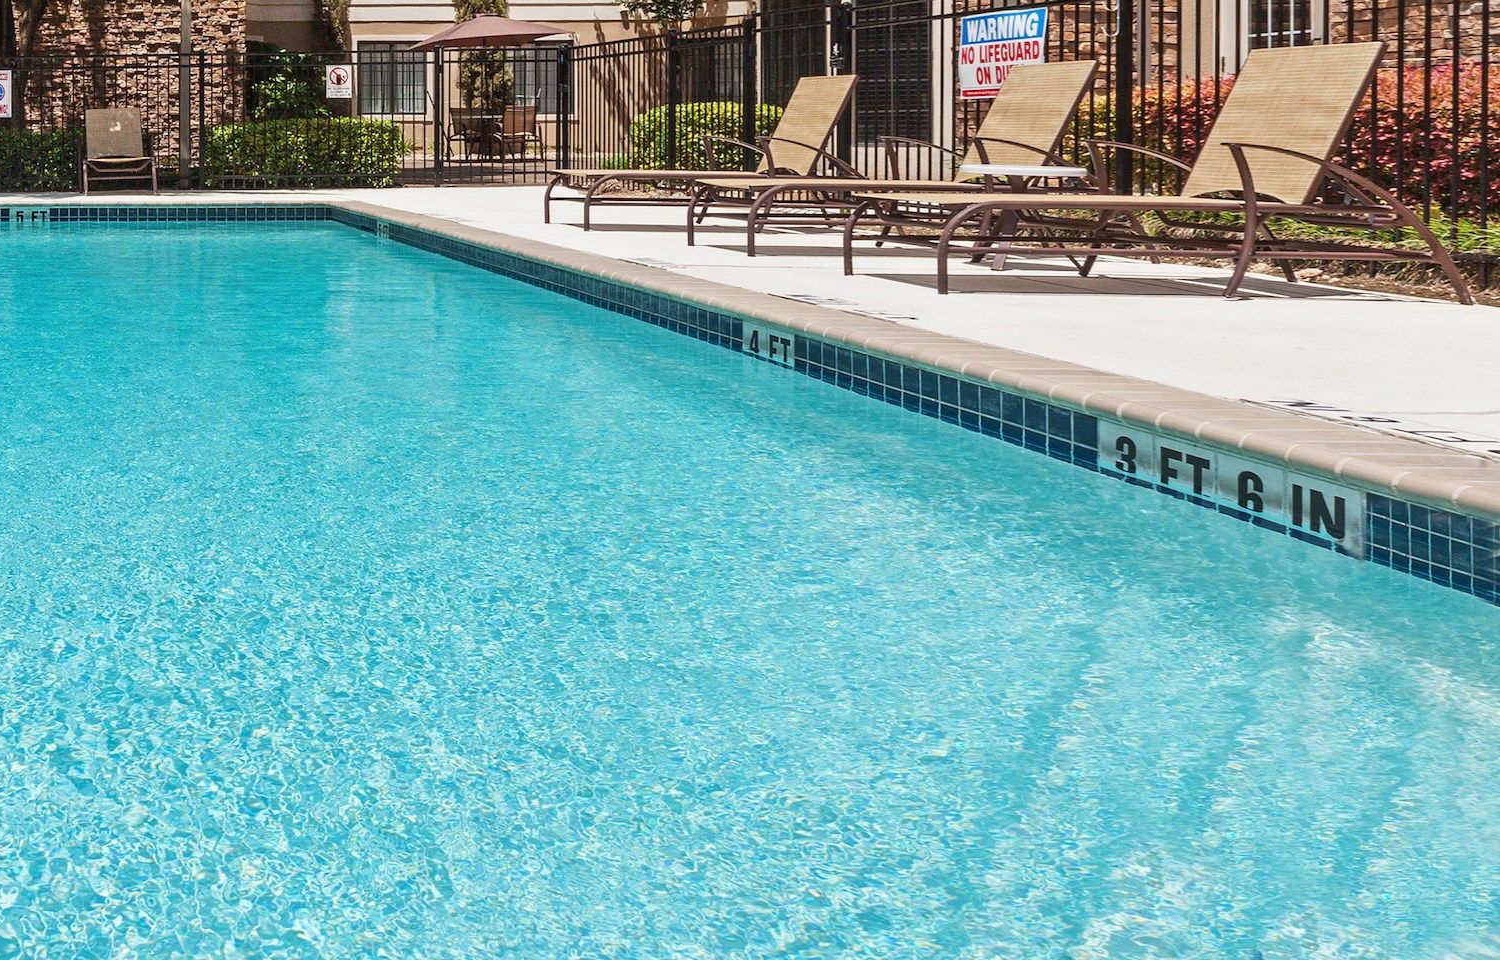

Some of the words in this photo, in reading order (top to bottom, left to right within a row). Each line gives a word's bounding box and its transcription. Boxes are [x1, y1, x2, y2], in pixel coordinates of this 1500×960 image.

[966, 12, 1039, 42] WARNING
[961, 46, 975, 65] NO
[980, 41, 1040, 63] LIFEGUARD
[976, 67, 992, 85] ON
[16, 211, 24, 223] 5
[31, 211, 47, 223] FT
[750, 330, 759, 353] 4
[769, 335, 791, 363] FT
[1115, 436, 1137, 474] 3
[1160, 447, 1211, 495] FT
[1237, 471, 1264, 513] 6
[1292, 484, 1346, 540] IN
